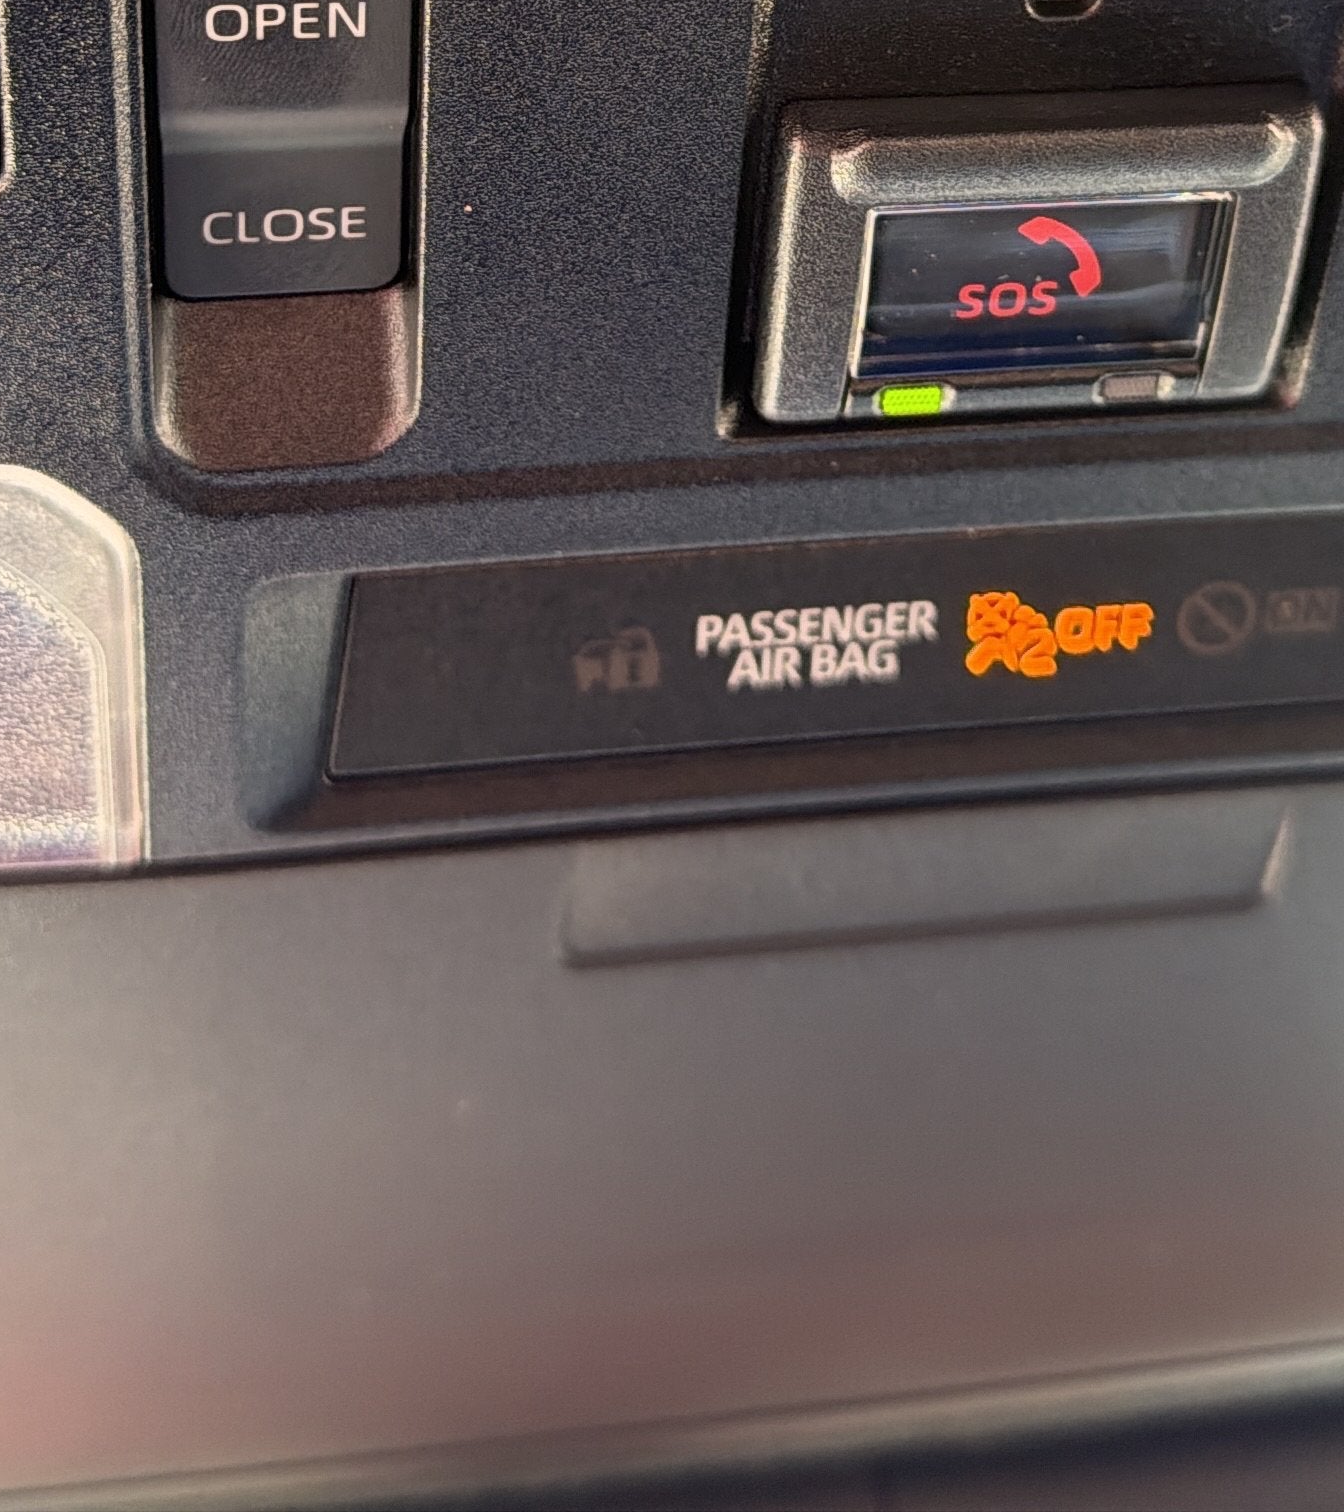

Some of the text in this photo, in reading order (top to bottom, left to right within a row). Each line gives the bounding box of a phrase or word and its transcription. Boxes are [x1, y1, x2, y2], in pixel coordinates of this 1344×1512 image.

[203, 0, 368, 44] OPEN
[201, 206, 369, 246] CLOSE
[955, 280, 1059, 320] SOS
[695, 599, 940, 657] PASSENGER
[1056, 601, 1155, 655] OFF
[726, 639, 901, 693] AIR BAG
